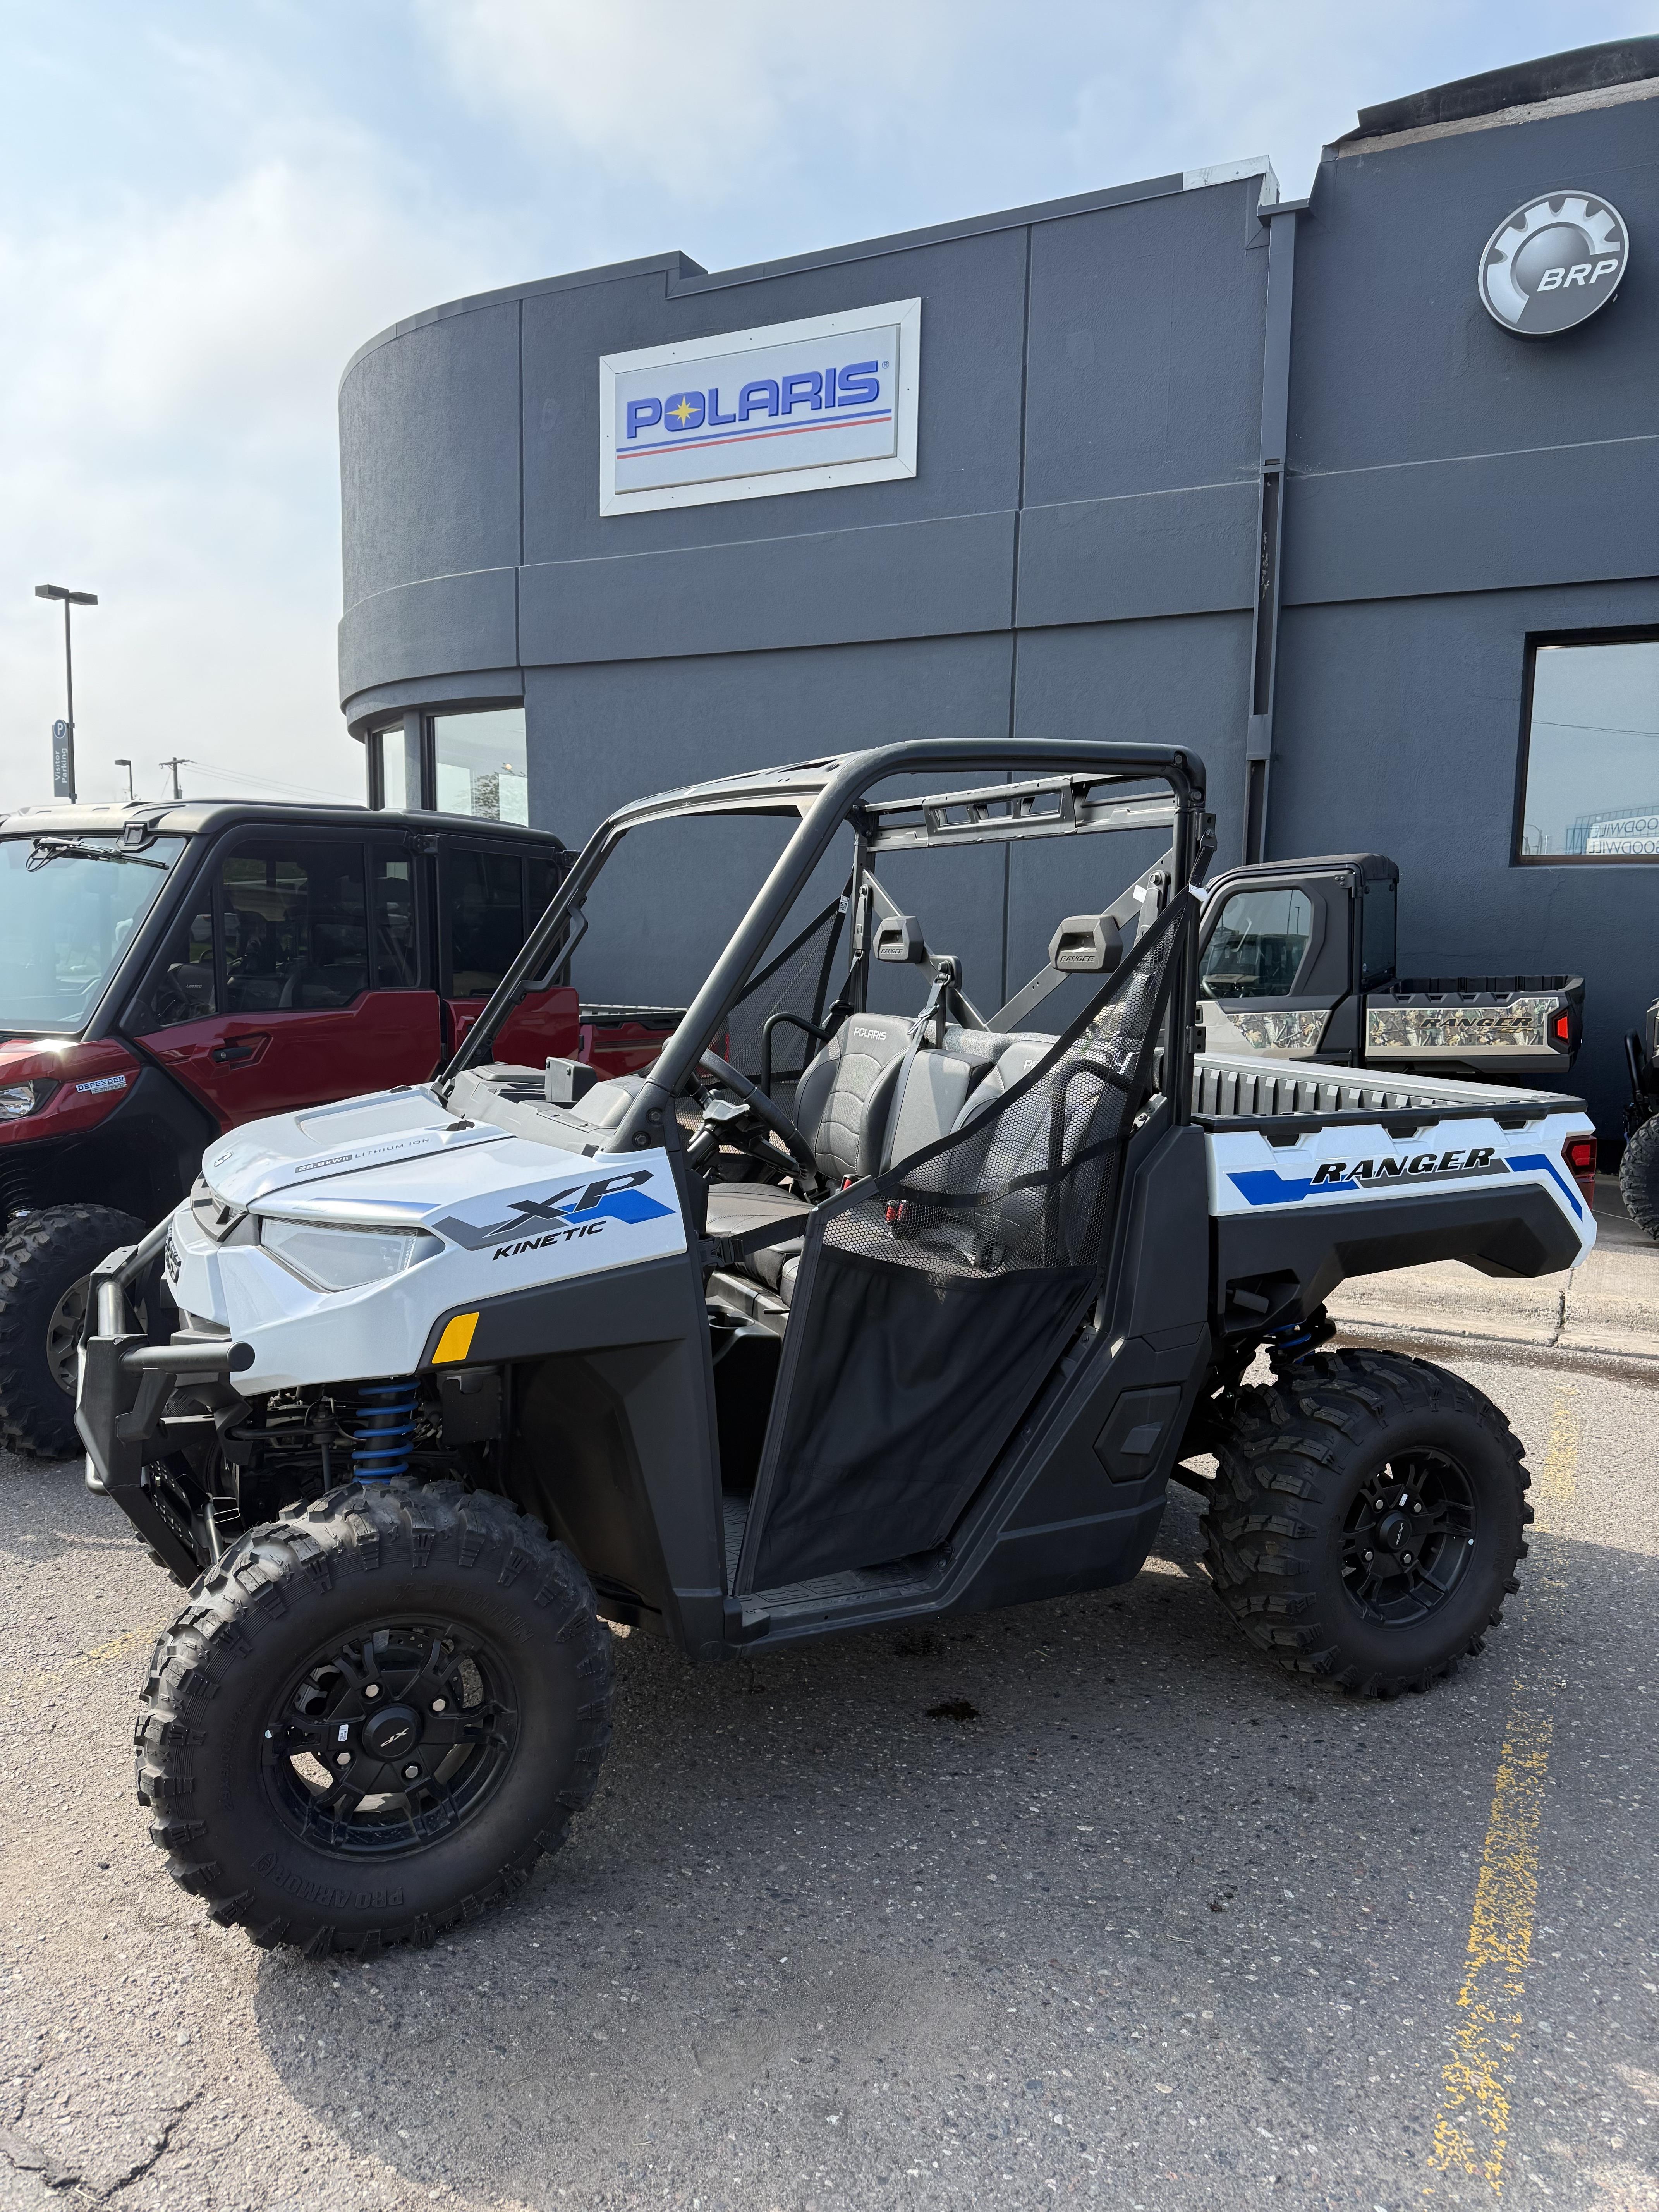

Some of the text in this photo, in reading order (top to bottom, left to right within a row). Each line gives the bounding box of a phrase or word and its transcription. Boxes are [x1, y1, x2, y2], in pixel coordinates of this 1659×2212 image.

[1537, 259, 1618, 292] BRP
[58, 723, 63, 735] P
[1419, 1017, 1532, 1027] RANGER
[854, 1027, 887, 1040] POLARIS
[78, 1076, 125, 1091] DEFENDER
[355, 1144, 404, 1158] LITHIUM
[1310, 1147, 1495, 1185] RANGER
[483, 1170, 654, 1237] XP
[492, 1220, 607, 1261] KINETIC
[380, 1728, 409, 1747] XP
[354, 1887, 404, 1909] PRO
